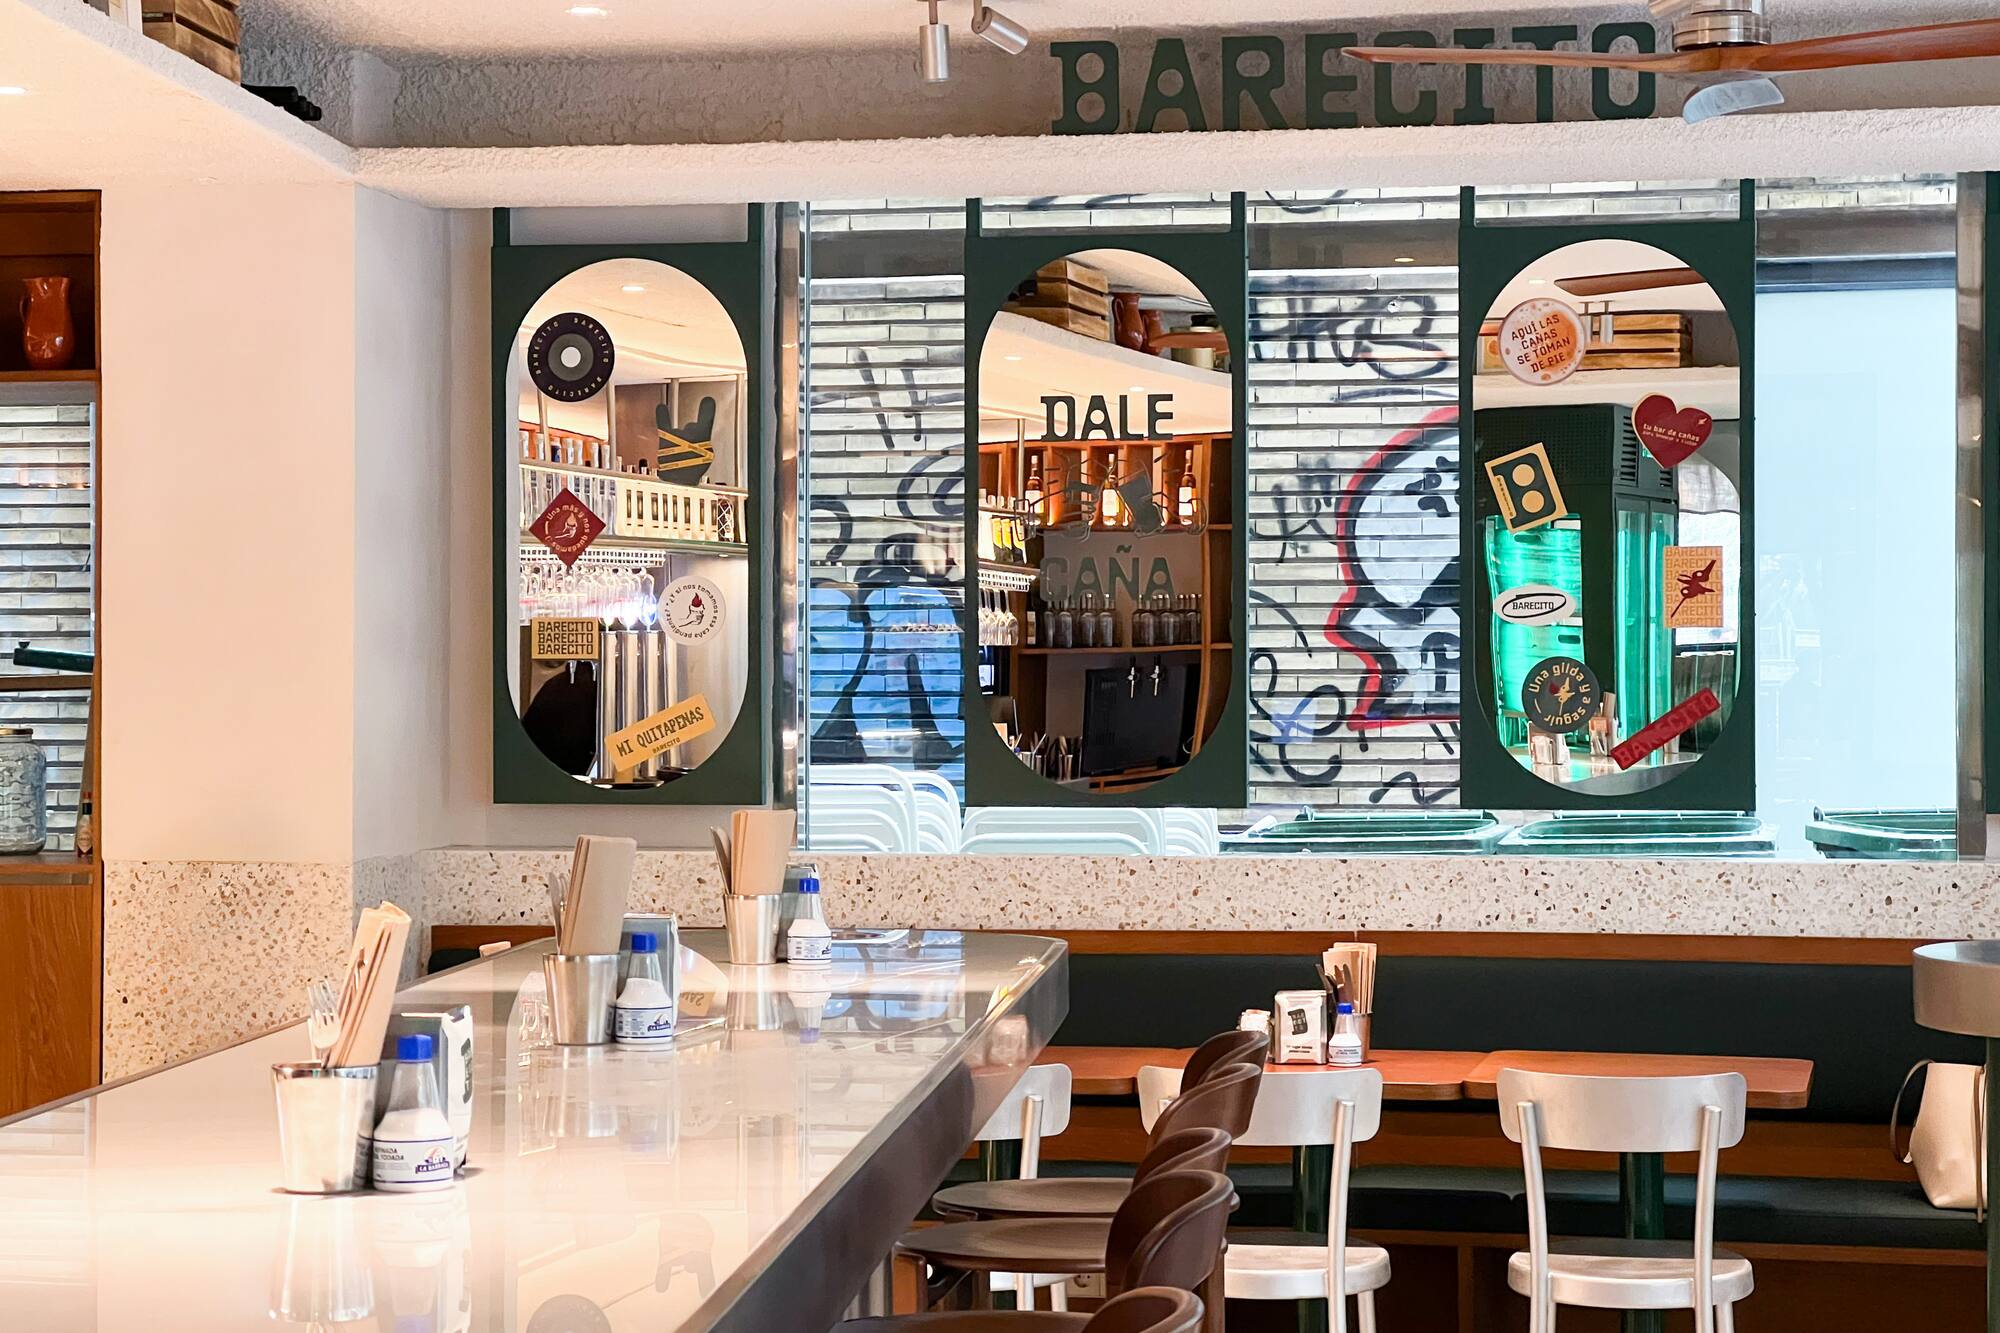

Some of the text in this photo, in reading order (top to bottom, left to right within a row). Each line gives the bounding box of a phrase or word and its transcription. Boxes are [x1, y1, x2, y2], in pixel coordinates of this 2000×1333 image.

[1050, 21, 1656, 136] BARECITO
[1511, 314, 1560, 341] AQUÍ LAS
[1521, 328, 1558, 350] CAÑAS
[1517, 336, 1571, 365] SE TOMAN
[1530, 352, 1566, 373] DE PIE
[1040, 393, 1173, 441] DALE
[1653, 425, 1666, 434] bar
[1667, 429, 1677, 437] de
[546, 507, 560, 520] Una
[552, 535, 588, 552] quedamos
[1039, 544, 1175, 601] CAÑA
[697, 584, 719, 614] tomamos
[709, 615, 718, 628] esa
[1512, 601, 1555, 610] BARECITO
[537, 621, 594, 632] BARECITO
[537, 632, 594, 643] BARECITO
[537, 643, 594, 655] BARECITO
[1528, 662, 1591, 727] Una gilda y a seguir
[615, 706, 705, 757] MI QUITAPENAS
